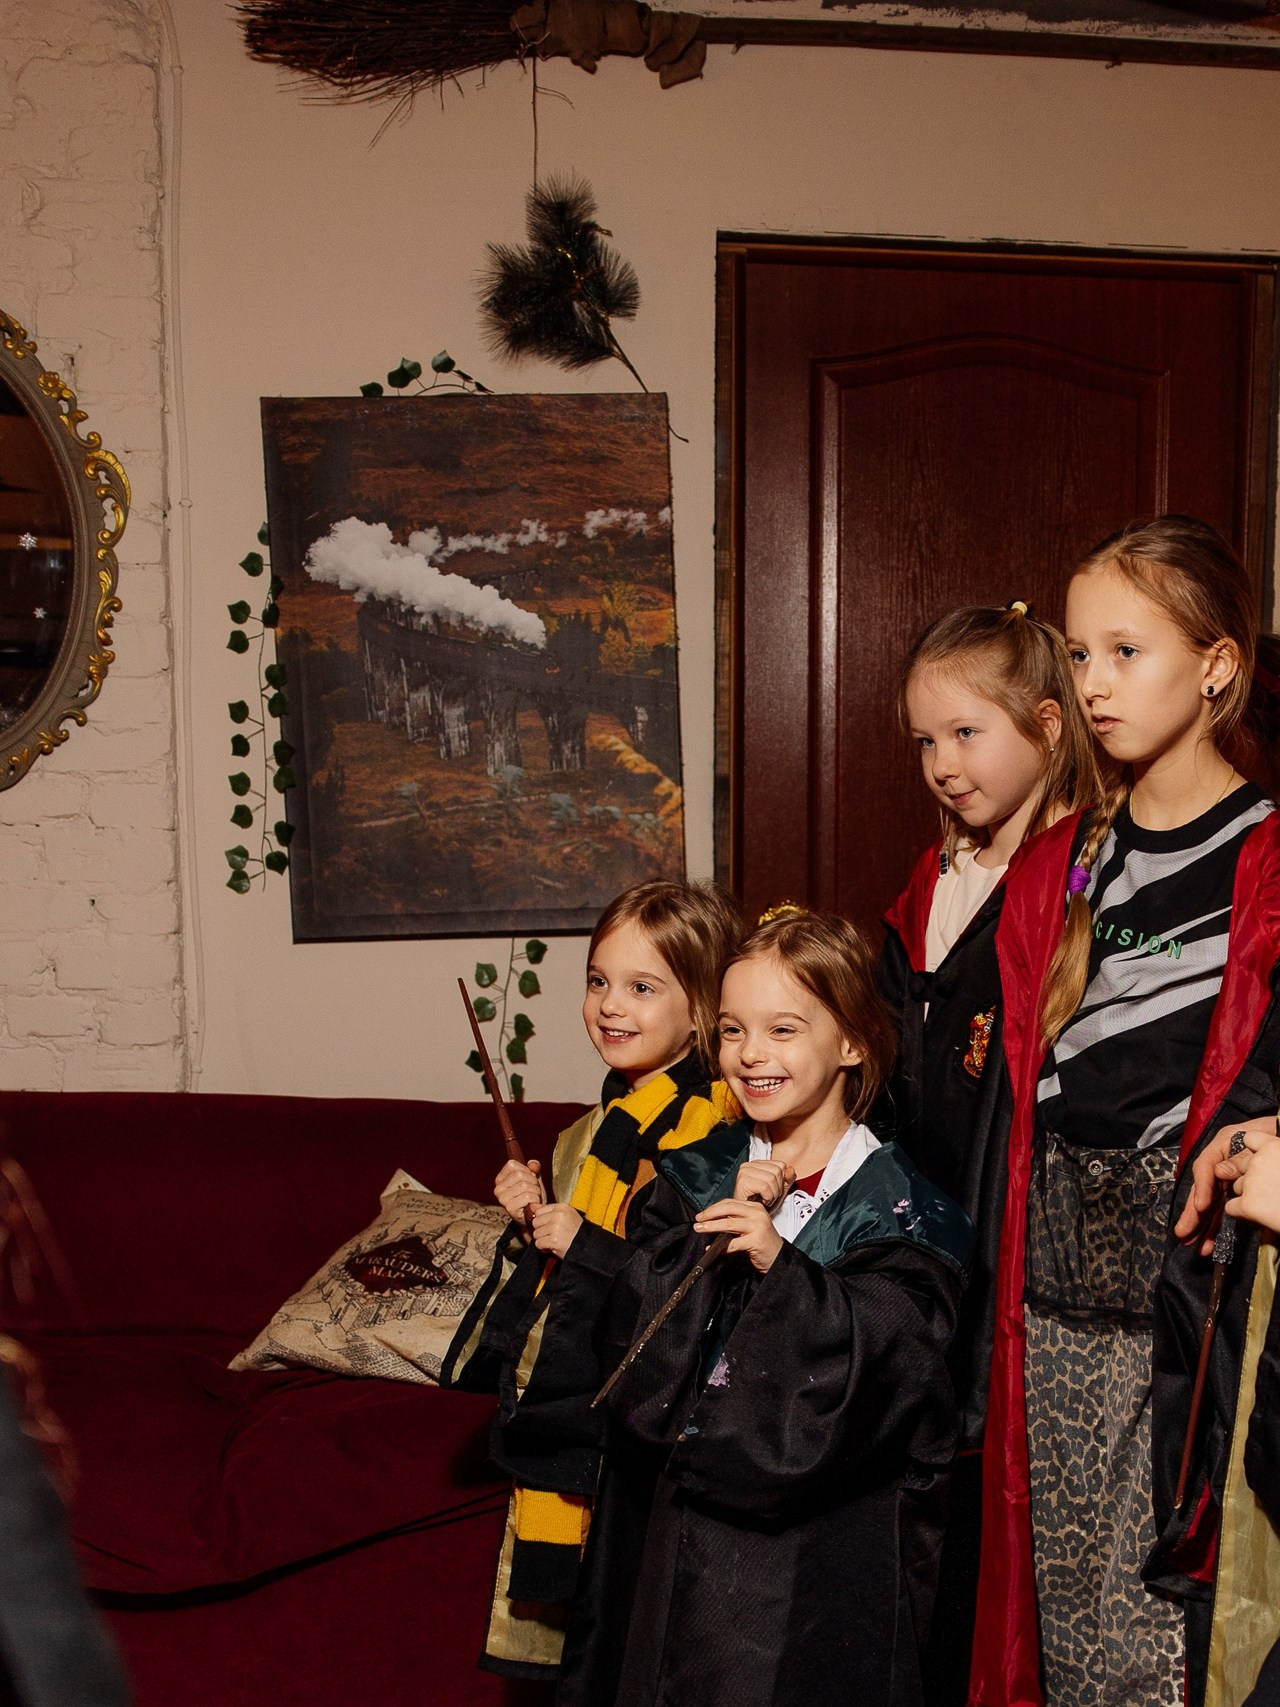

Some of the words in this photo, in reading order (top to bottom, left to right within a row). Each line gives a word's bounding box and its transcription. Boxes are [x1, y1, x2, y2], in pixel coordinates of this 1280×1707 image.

[1095, 920, 1182, 960] CISION
[353, 1257, 443, 1283] MARAUDER'S
[368, 1265, 406, 1279] MAP
